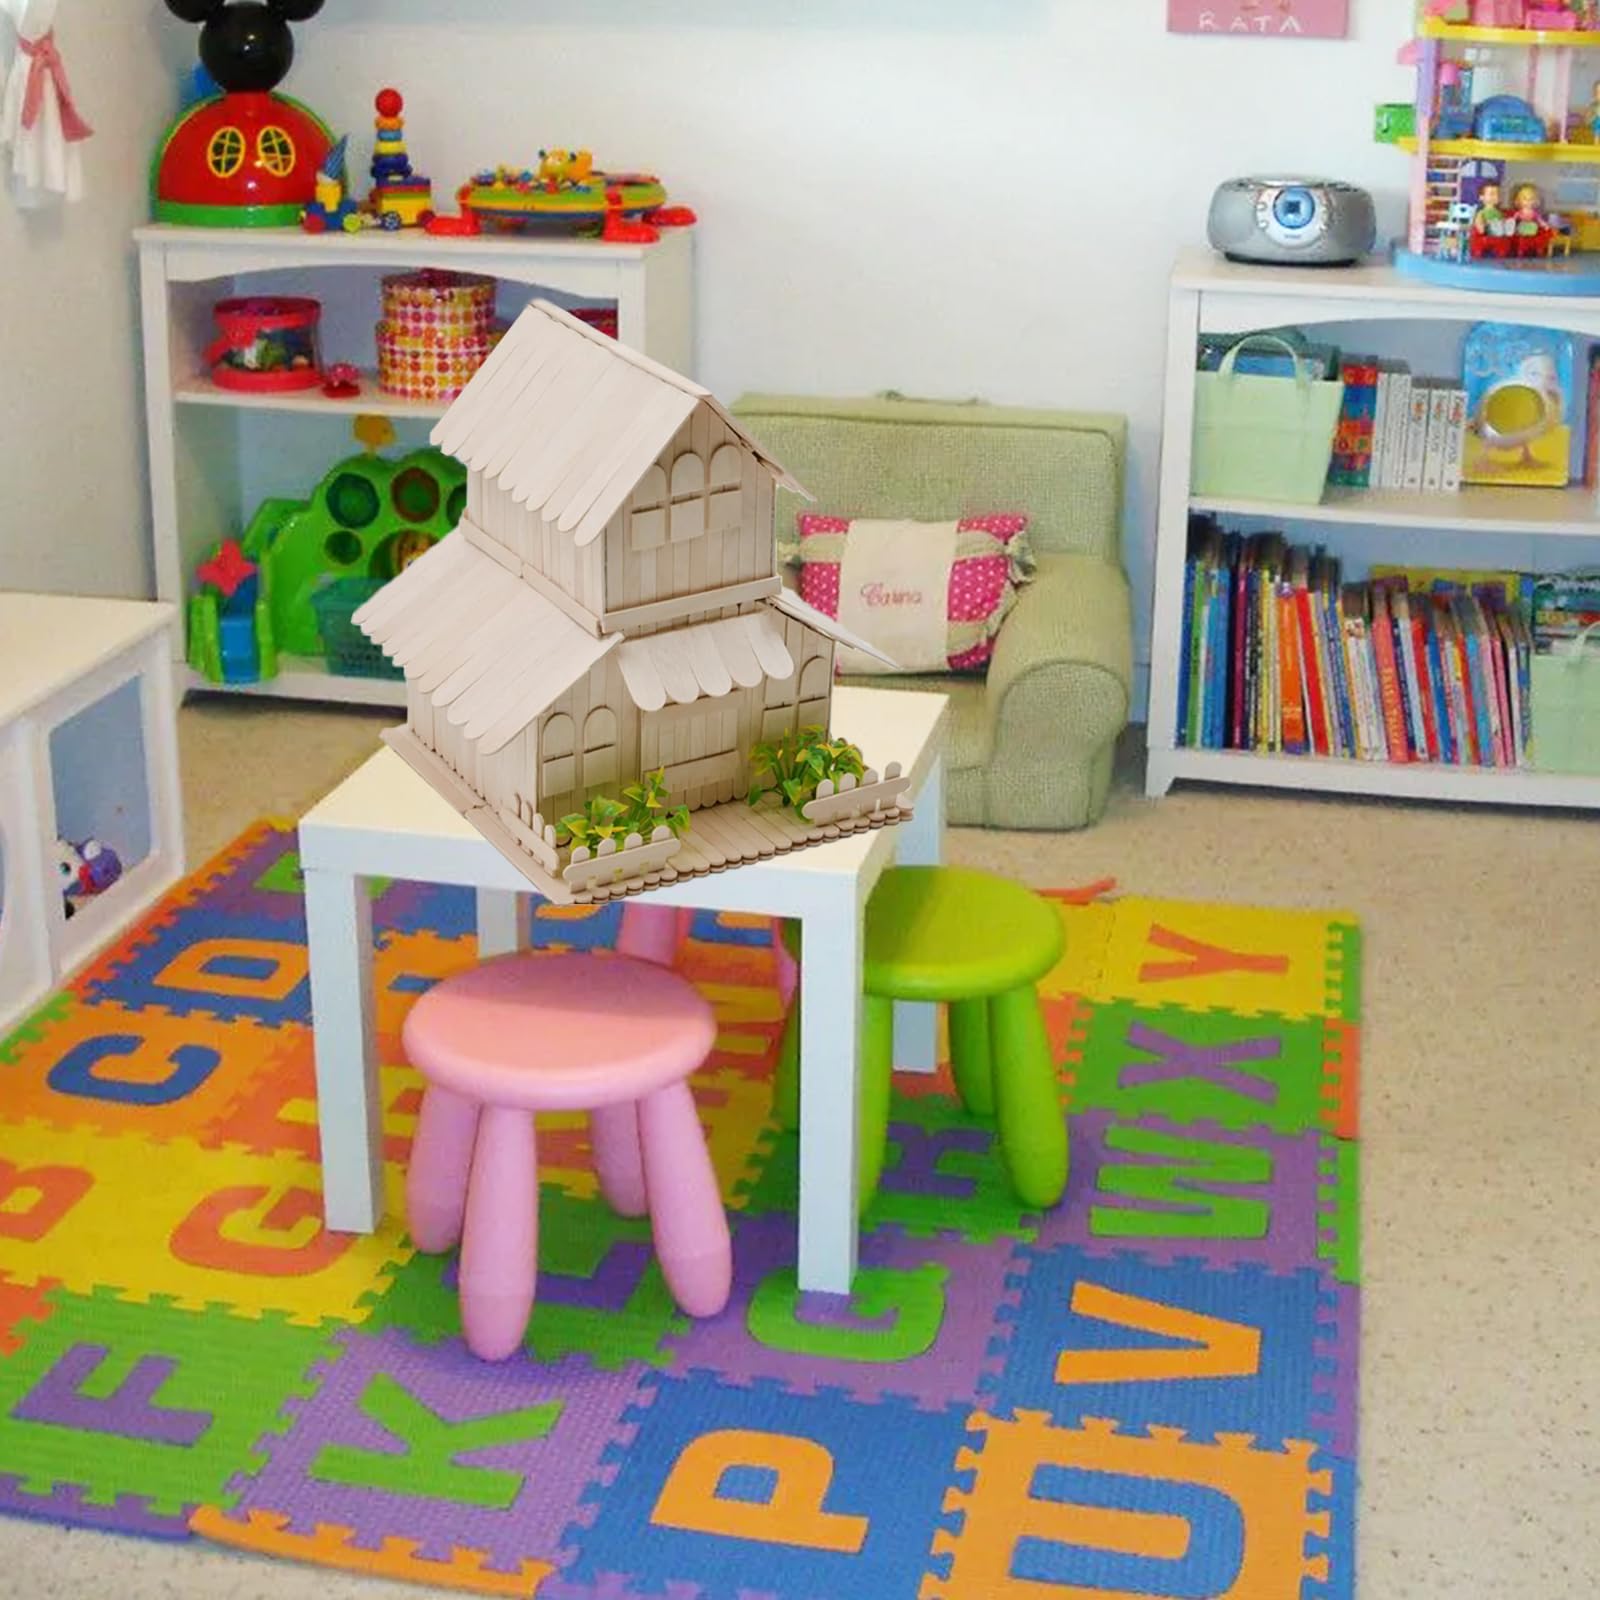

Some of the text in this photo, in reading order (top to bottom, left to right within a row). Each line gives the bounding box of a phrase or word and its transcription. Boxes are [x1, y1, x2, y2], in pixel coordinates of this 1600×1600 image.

[153, 938, 310, 1000] D
[1139, 924, 1289, 983] Y
[46, 1034, 222, 1106] C
[1117, 1021, 1281, 1104] X
[168, 1184, 360, 1278] G
[1090, 1125, 1272, 1239] W
[1054, 1281, 1261, 1384] V
[10, 1341, 214, 1448] F
[311, 1373, 564, 1510] K
[649, 1428, 870, 1554] P
[1008, 1462, 1246, 1600] U
